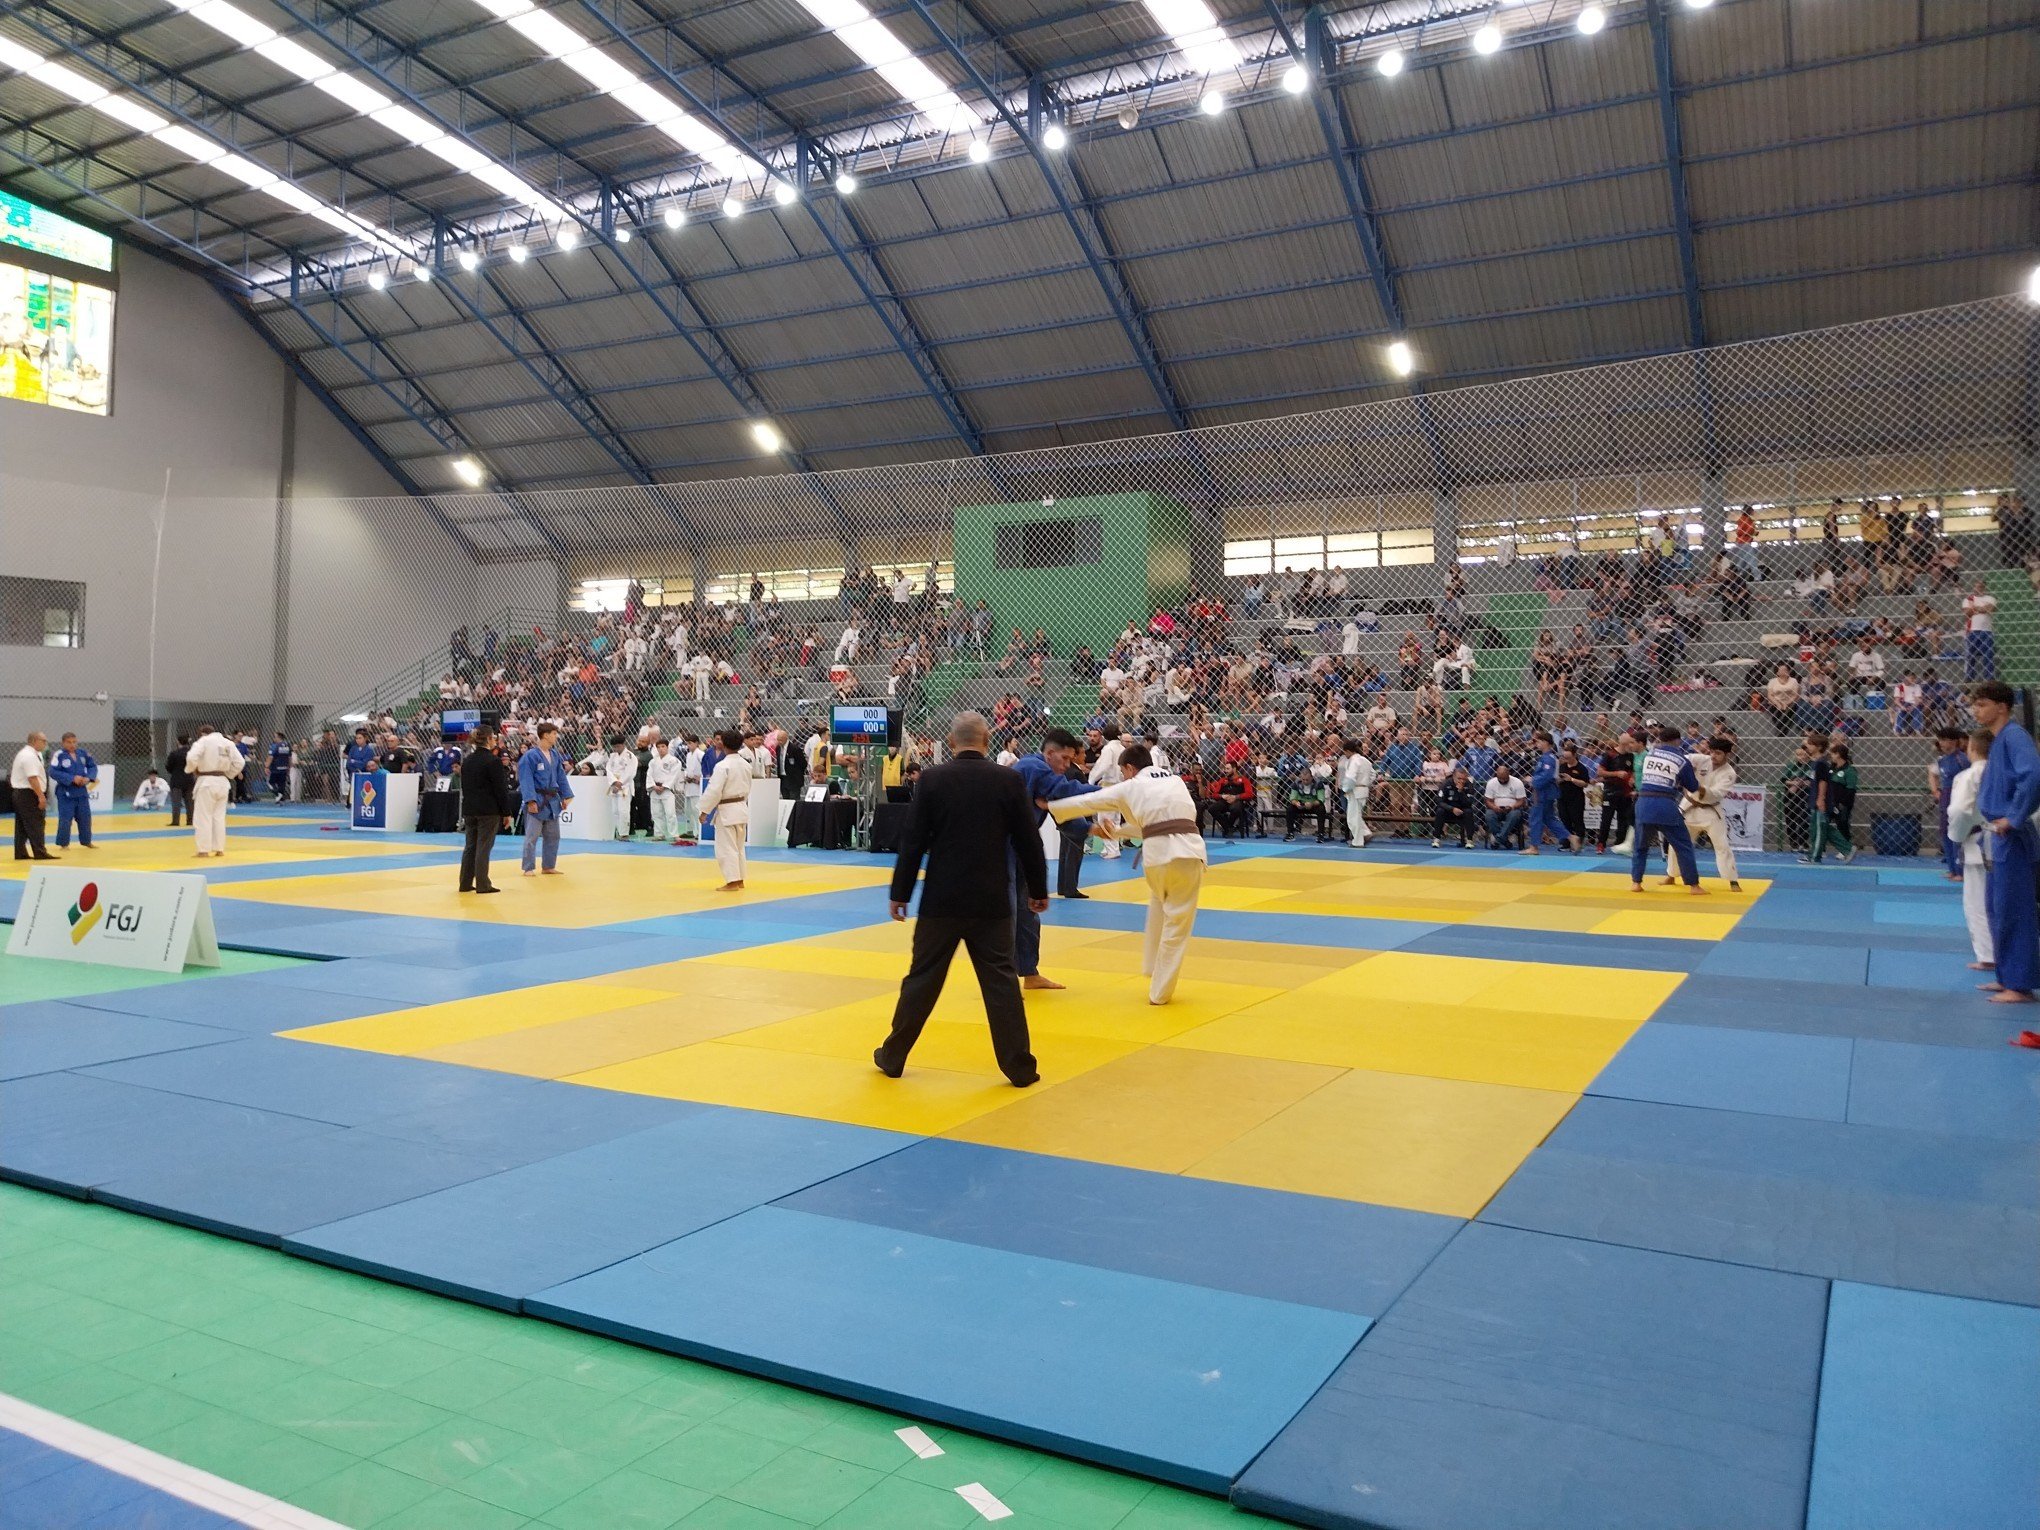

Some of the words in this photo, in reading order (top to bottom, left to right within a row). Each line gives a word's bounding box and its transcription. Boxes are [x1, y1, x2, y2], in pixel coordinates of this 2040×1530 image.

[863, 709, 879, 719] 000
[863, 721, 879, 732] 000
[1646, 760, 1671, 774] BRA
[361, 805, 375, 818] FGJ
[559, 811, 573, 823] GJ
[105, 903, 143, 932] FGJ
